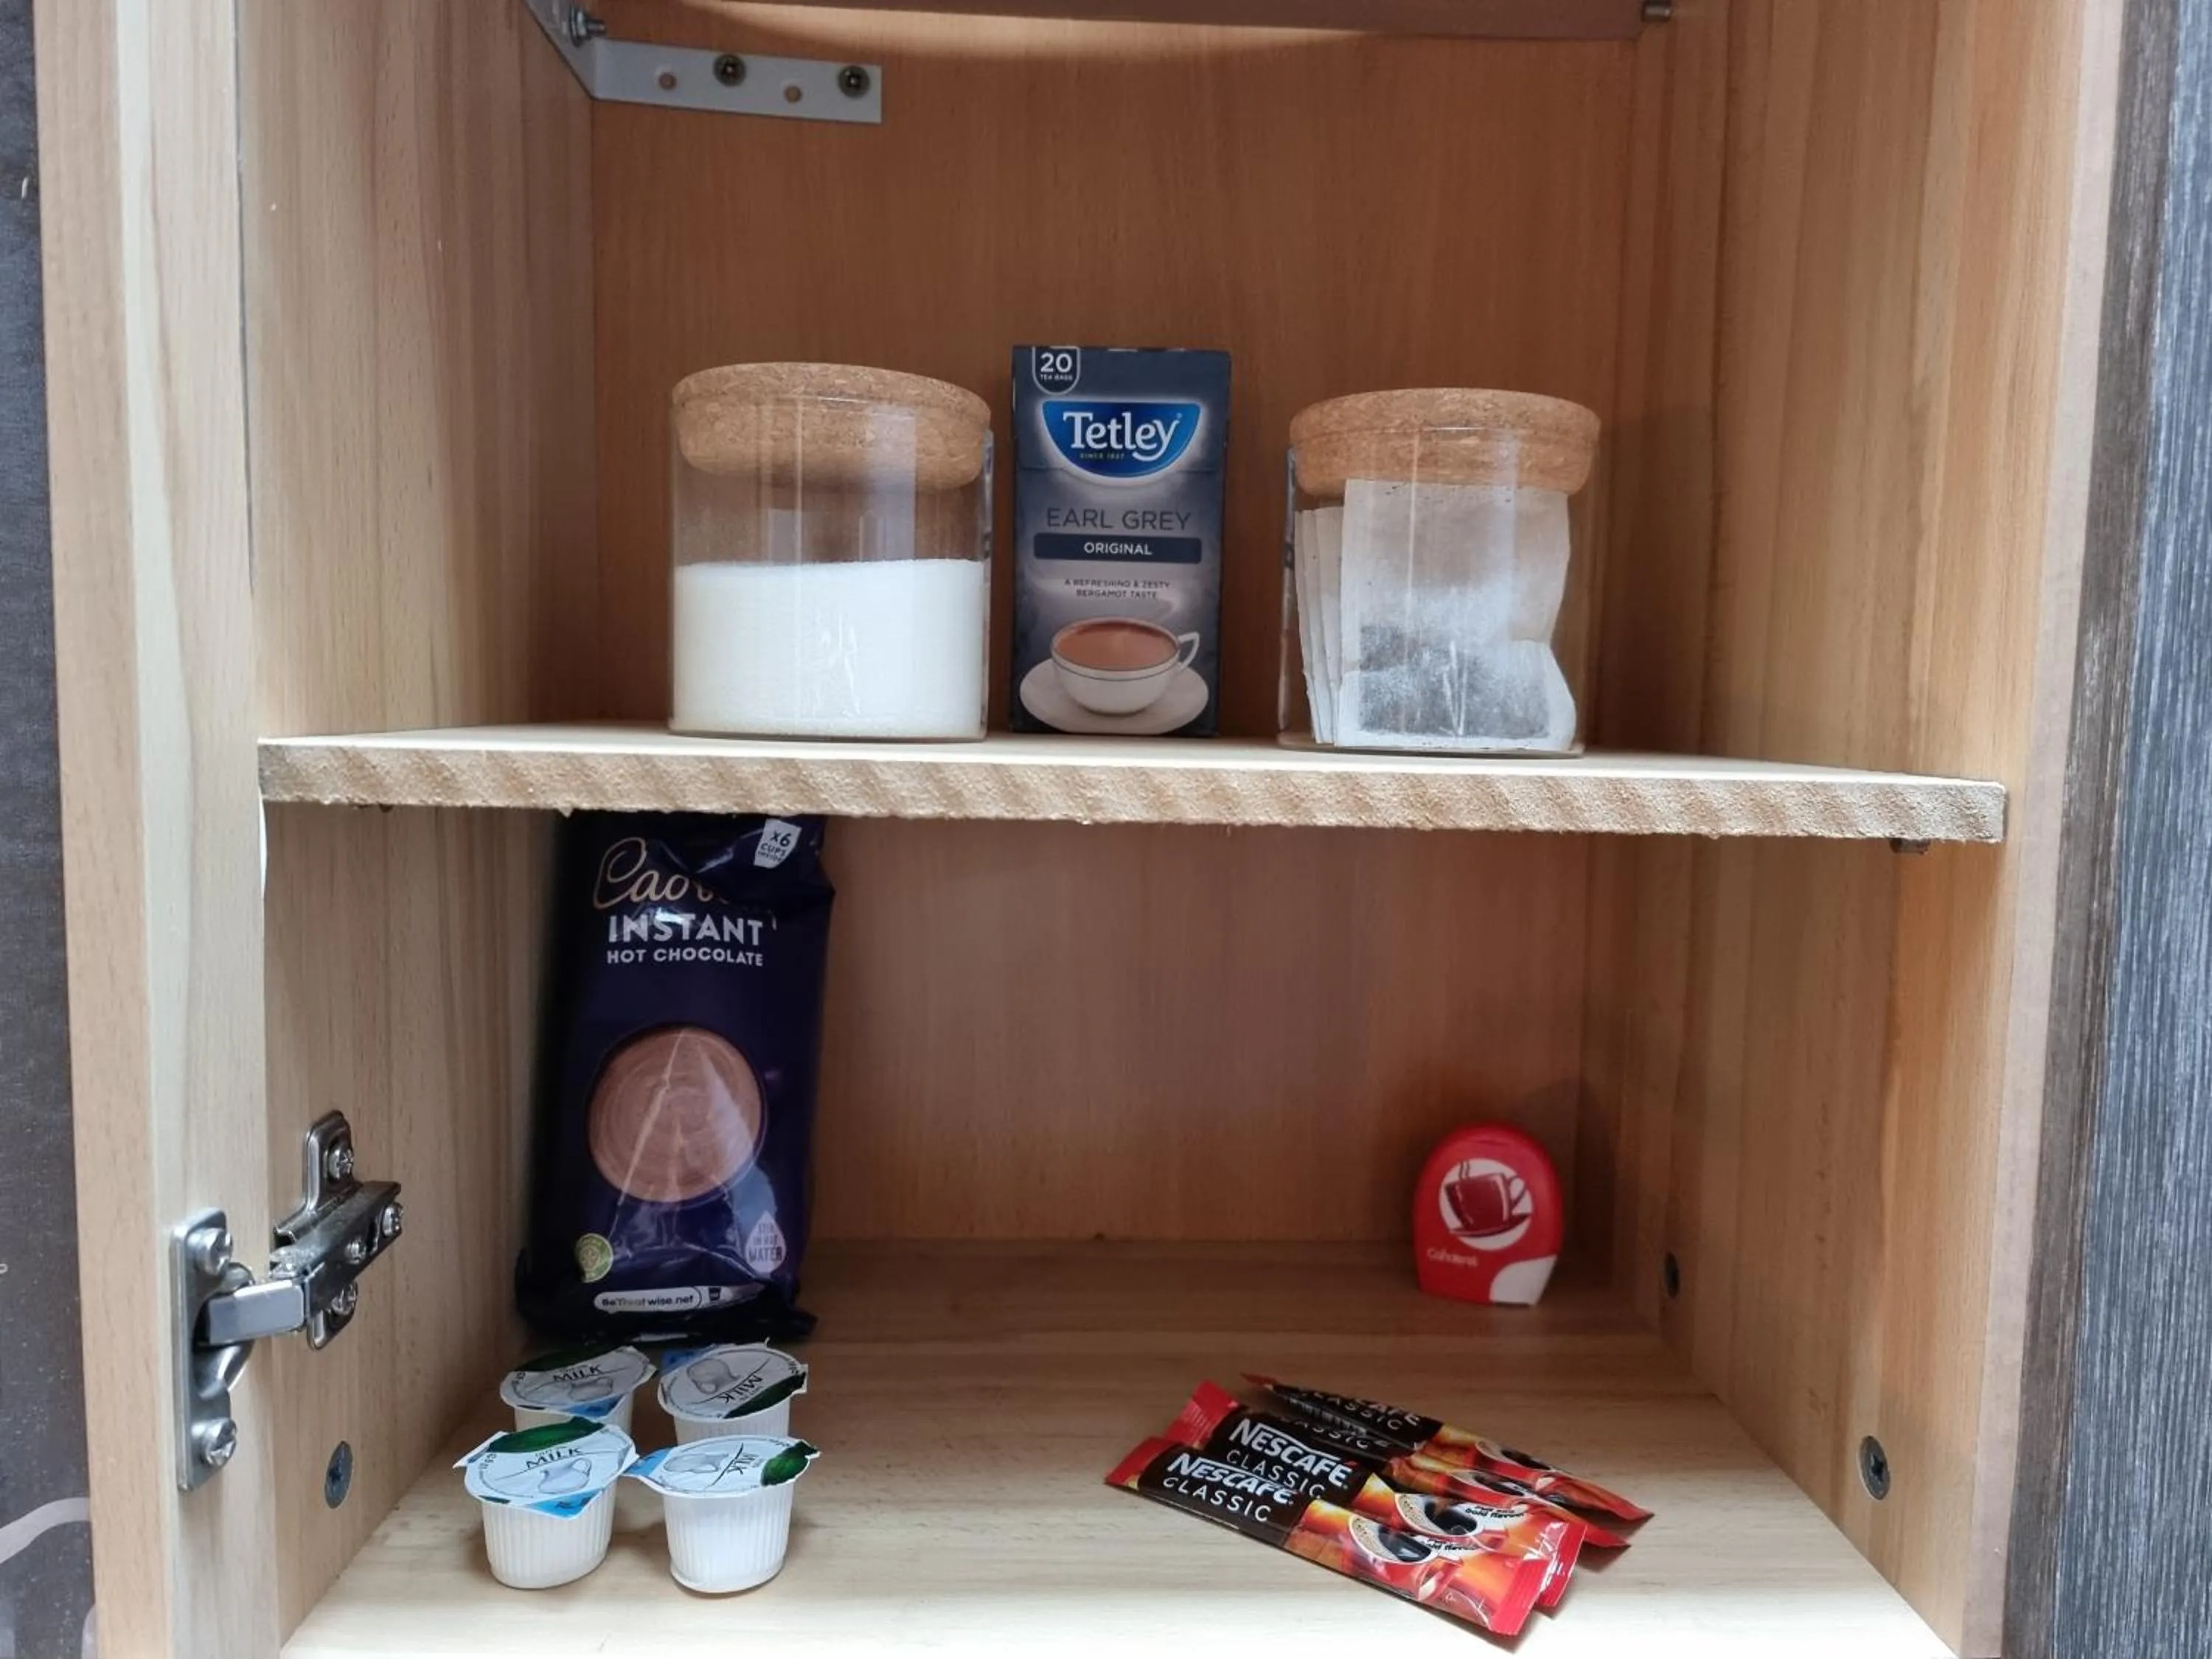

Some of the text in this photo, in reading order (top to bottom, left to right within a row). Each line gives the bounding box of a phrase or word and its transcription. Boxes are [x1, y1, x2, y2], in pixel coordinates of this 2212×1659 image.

[1040, 352, 1072, 372] 20
[1062, 411, 1180, 462] Tetley
[1047, 507, 1192, 531] EARL GREY
[1083, 542, 1152, 556] ORIGINAL
[1073, 579, 1131, 588] REFRESHING
[1142, 580, 1170, 589] ZESTY
[1076, 589, 1157, 599] BERGAMOT TASTE
[608, 913, 764, 947] INSTANT
[607, 947, 764, 967] HOT CHOCOLATE
[553, 1364, 602, 1382] MILK
[717, 1374, 763, 1405] MILK
[525, 1447, 585, 1470] MILK
[1226, 1449, 1326, 1499] CLASSIC
[1163, 1477, 1272, 1522] CLASSIC
